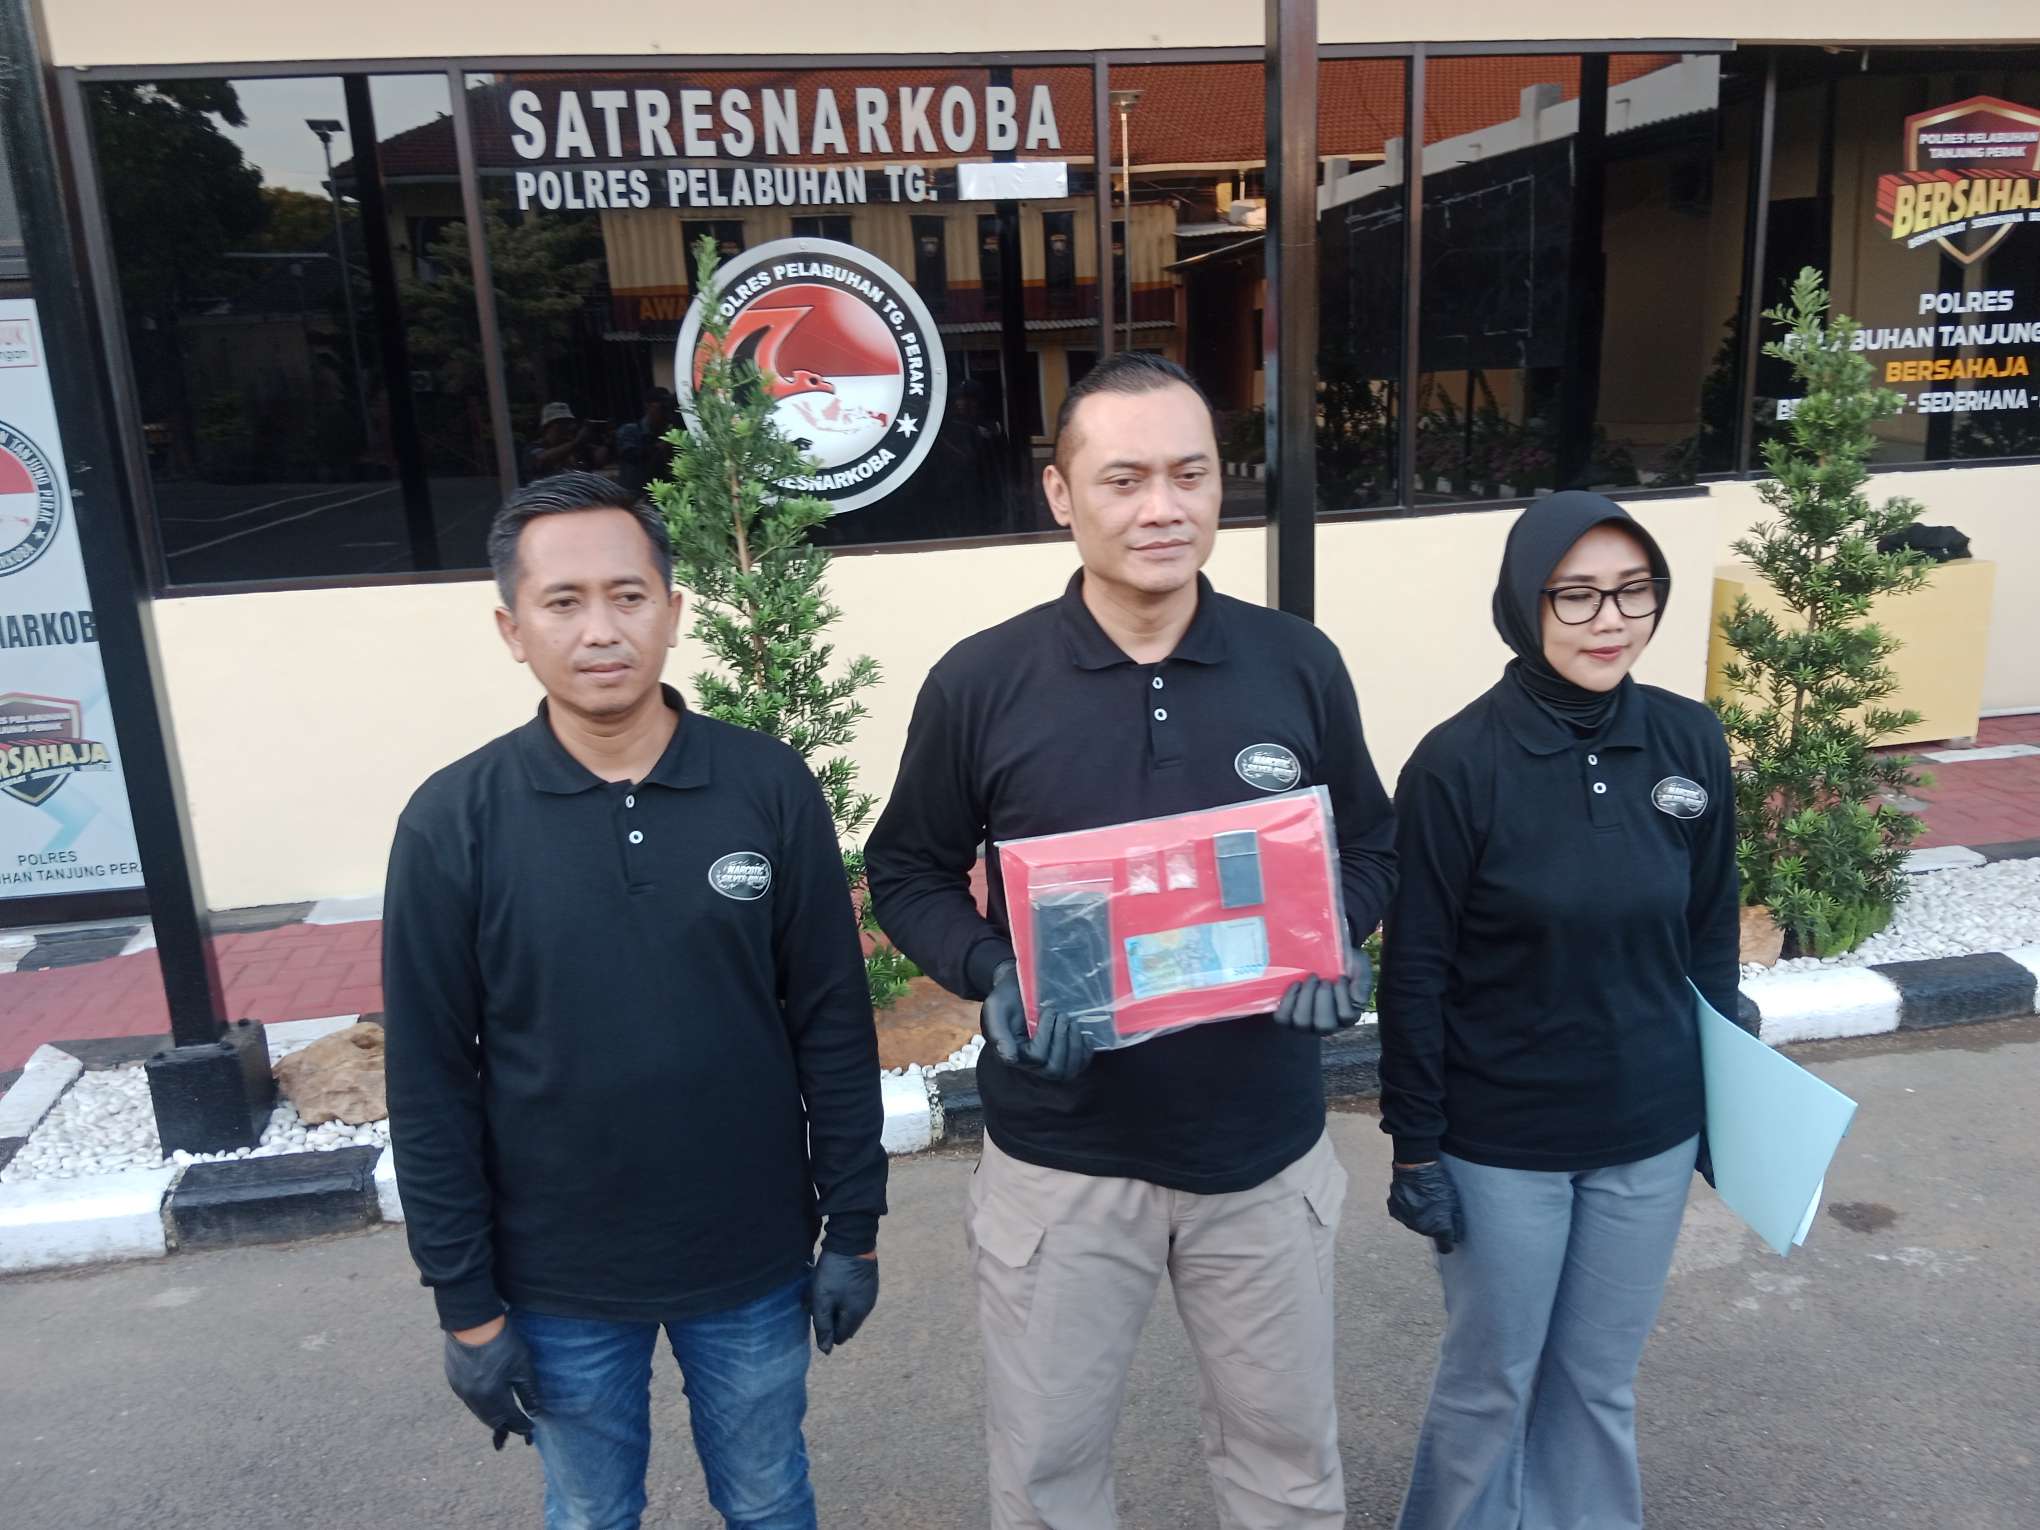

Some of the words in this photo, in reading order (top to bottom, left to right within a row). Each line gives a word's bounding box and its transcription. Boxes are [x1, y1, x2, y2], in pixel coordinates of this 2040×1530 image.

[509, 85, 1061, 159] SATRESNARKOBA
[515, 169, 650, 210] POLRES
[667, 166, 867, 207] PELABUHAN
[884, 165, 938, 203] TG.
[1919, 290, 2014, 315] POLRES
[713, 271, 772, 325] OLRES
[773, 262, 885, 303] PELABUHAN
[883, 299, 905, 331] TG.
[900, 332, 924, 396] PERAK
[1886, 356, 2029, 383] BERSAHAJA
[1917, 389, 2029, 414] SEDERHANA
[18, 851, 78, 865] POLRES
[0, 872, 32, 884] HAN
[36, 865, 105, 880] TANJUNG
[110, 862, 142, 875] PER
